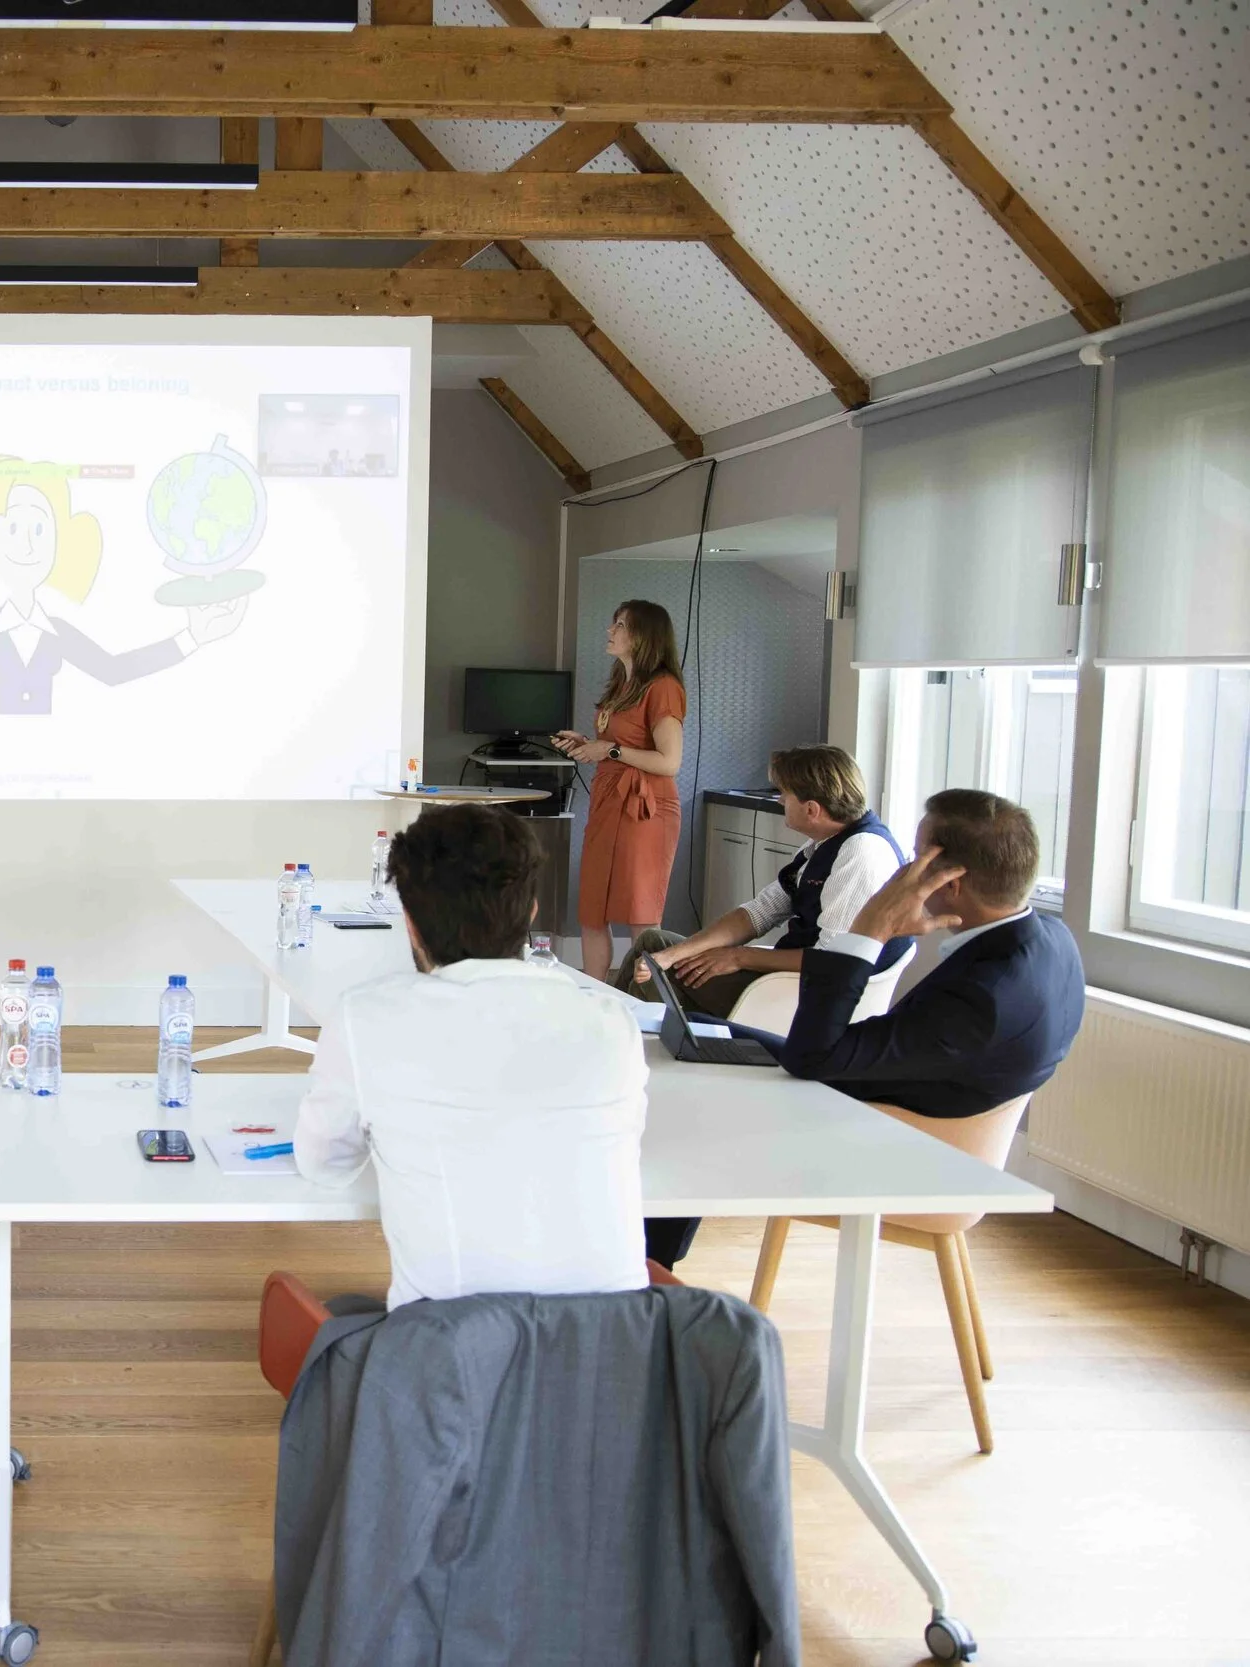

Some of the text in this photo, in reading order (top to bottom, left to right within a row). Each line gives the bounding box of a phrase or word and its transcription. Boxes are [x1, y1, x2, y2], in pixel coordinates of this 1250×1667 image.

[37, 378, 100, 392] versus
[107, 375, 190, 395] beloning
[4, 1005, 23, 1013] SPA
